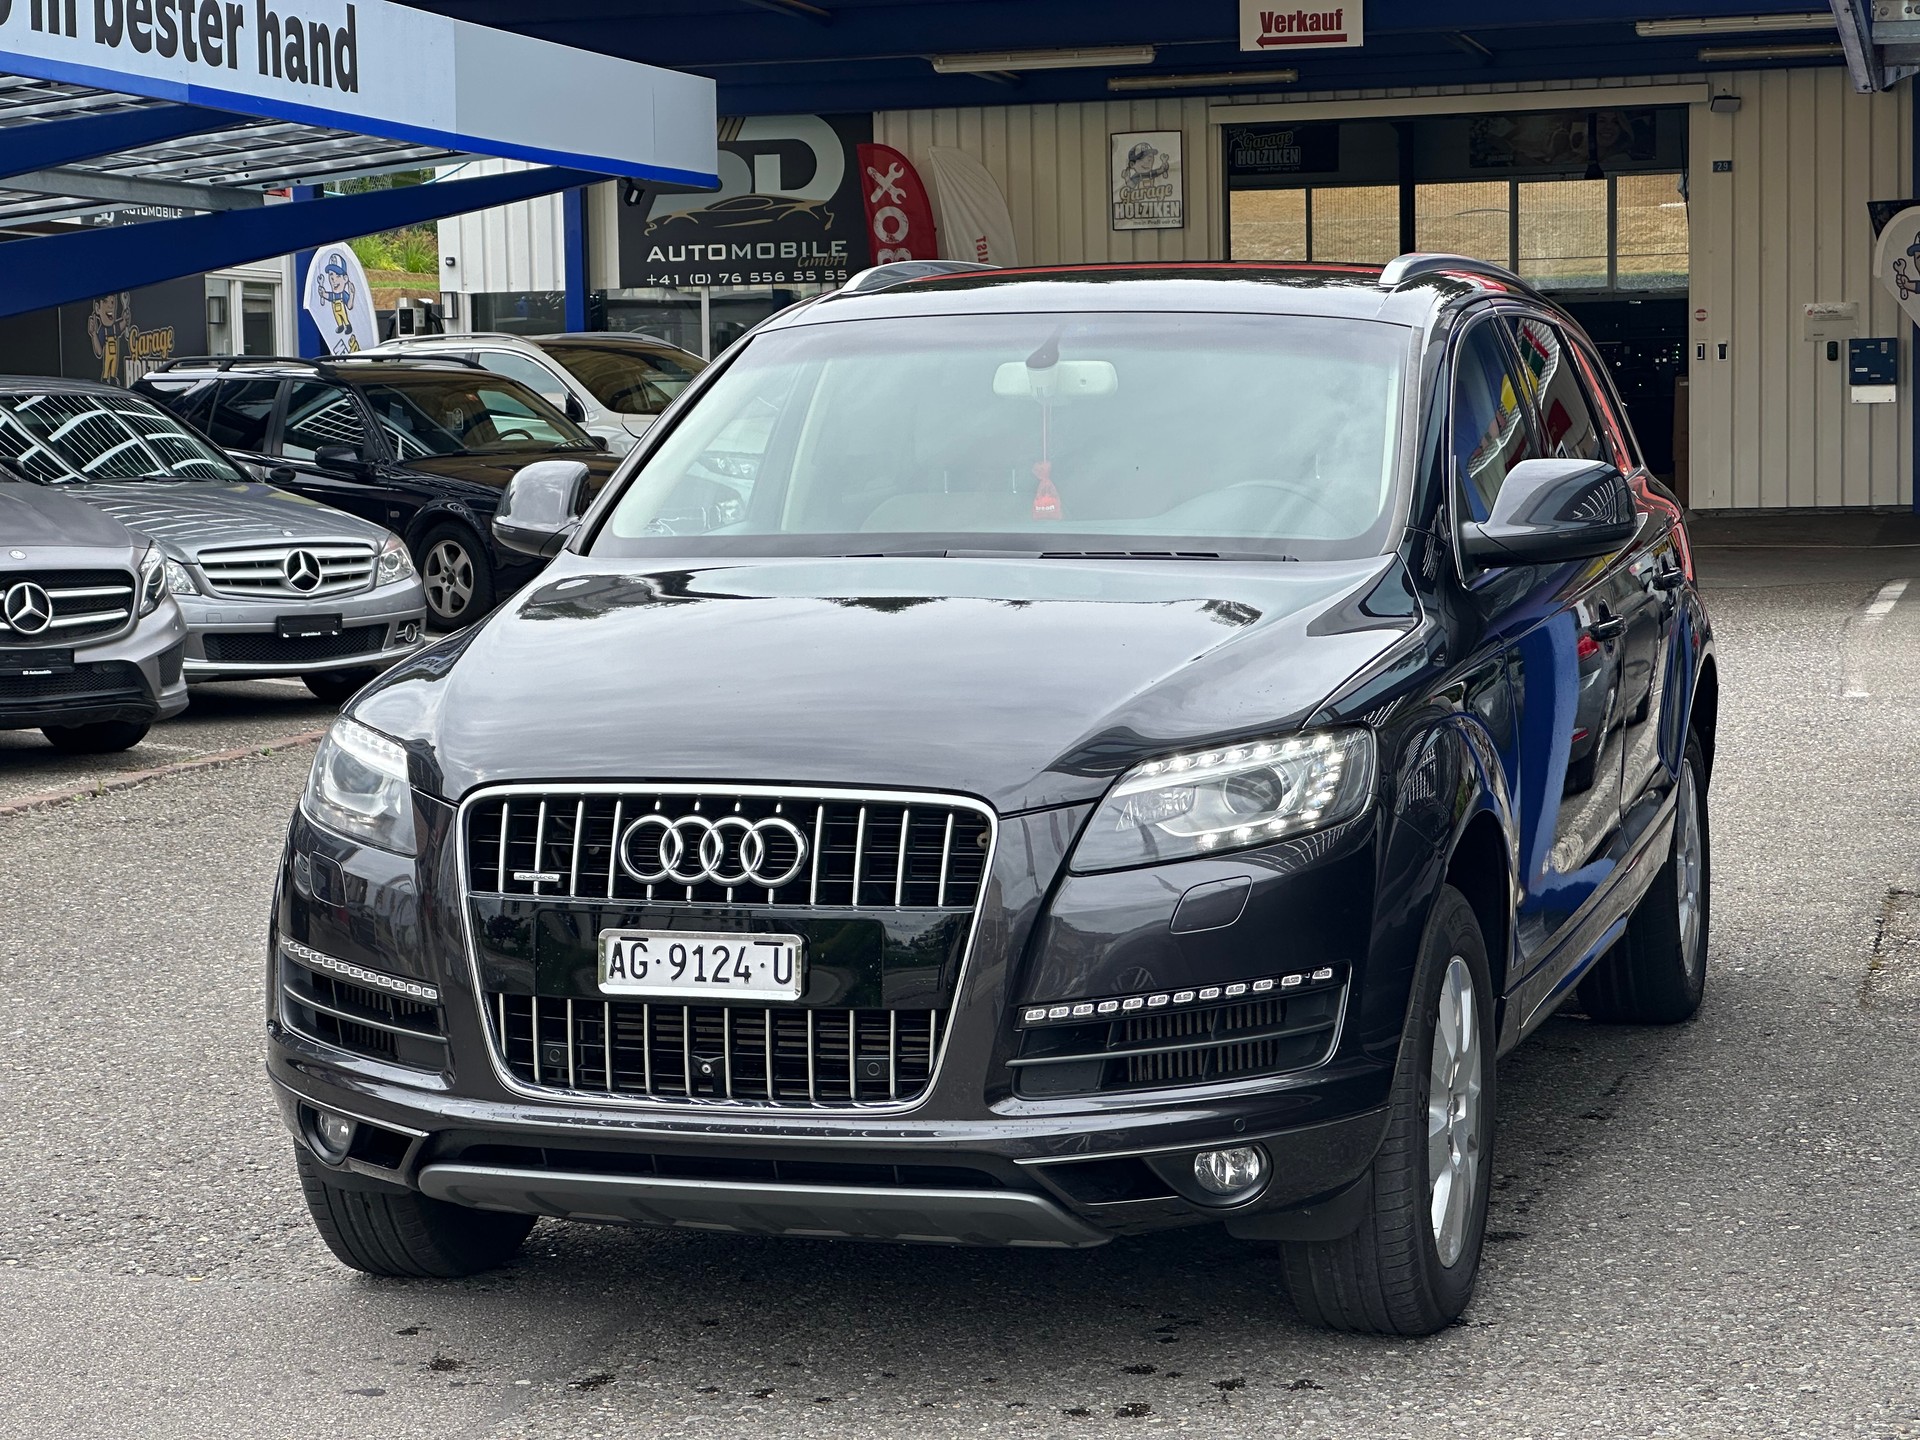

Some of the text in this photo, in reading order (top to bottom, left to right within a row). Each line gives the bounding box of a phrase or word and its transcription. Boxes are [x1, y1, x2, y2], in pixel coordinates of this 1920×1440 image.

[1260, 8, 1343, 34] Verkauf
[94, 0, 244, 70] bester
[256, 0, 359, 94] hand
[1242, 132, 1293, 151] Garage
[1237, 148, 1299, 165] HOLZIKEN
[1717, 162, 1729, 171] 29
[1120, 184, 1173, 204] Garage
[1115, 201, 1180, 219] HOLZIKEN
[646, 240, 847, 262] AUTOMOBILE
[797, 252, 849, 268] GmbH
[646, 269, 848, 285] +41 (0) 76 556 55 55
[129, 326, 174, 361] Garage
